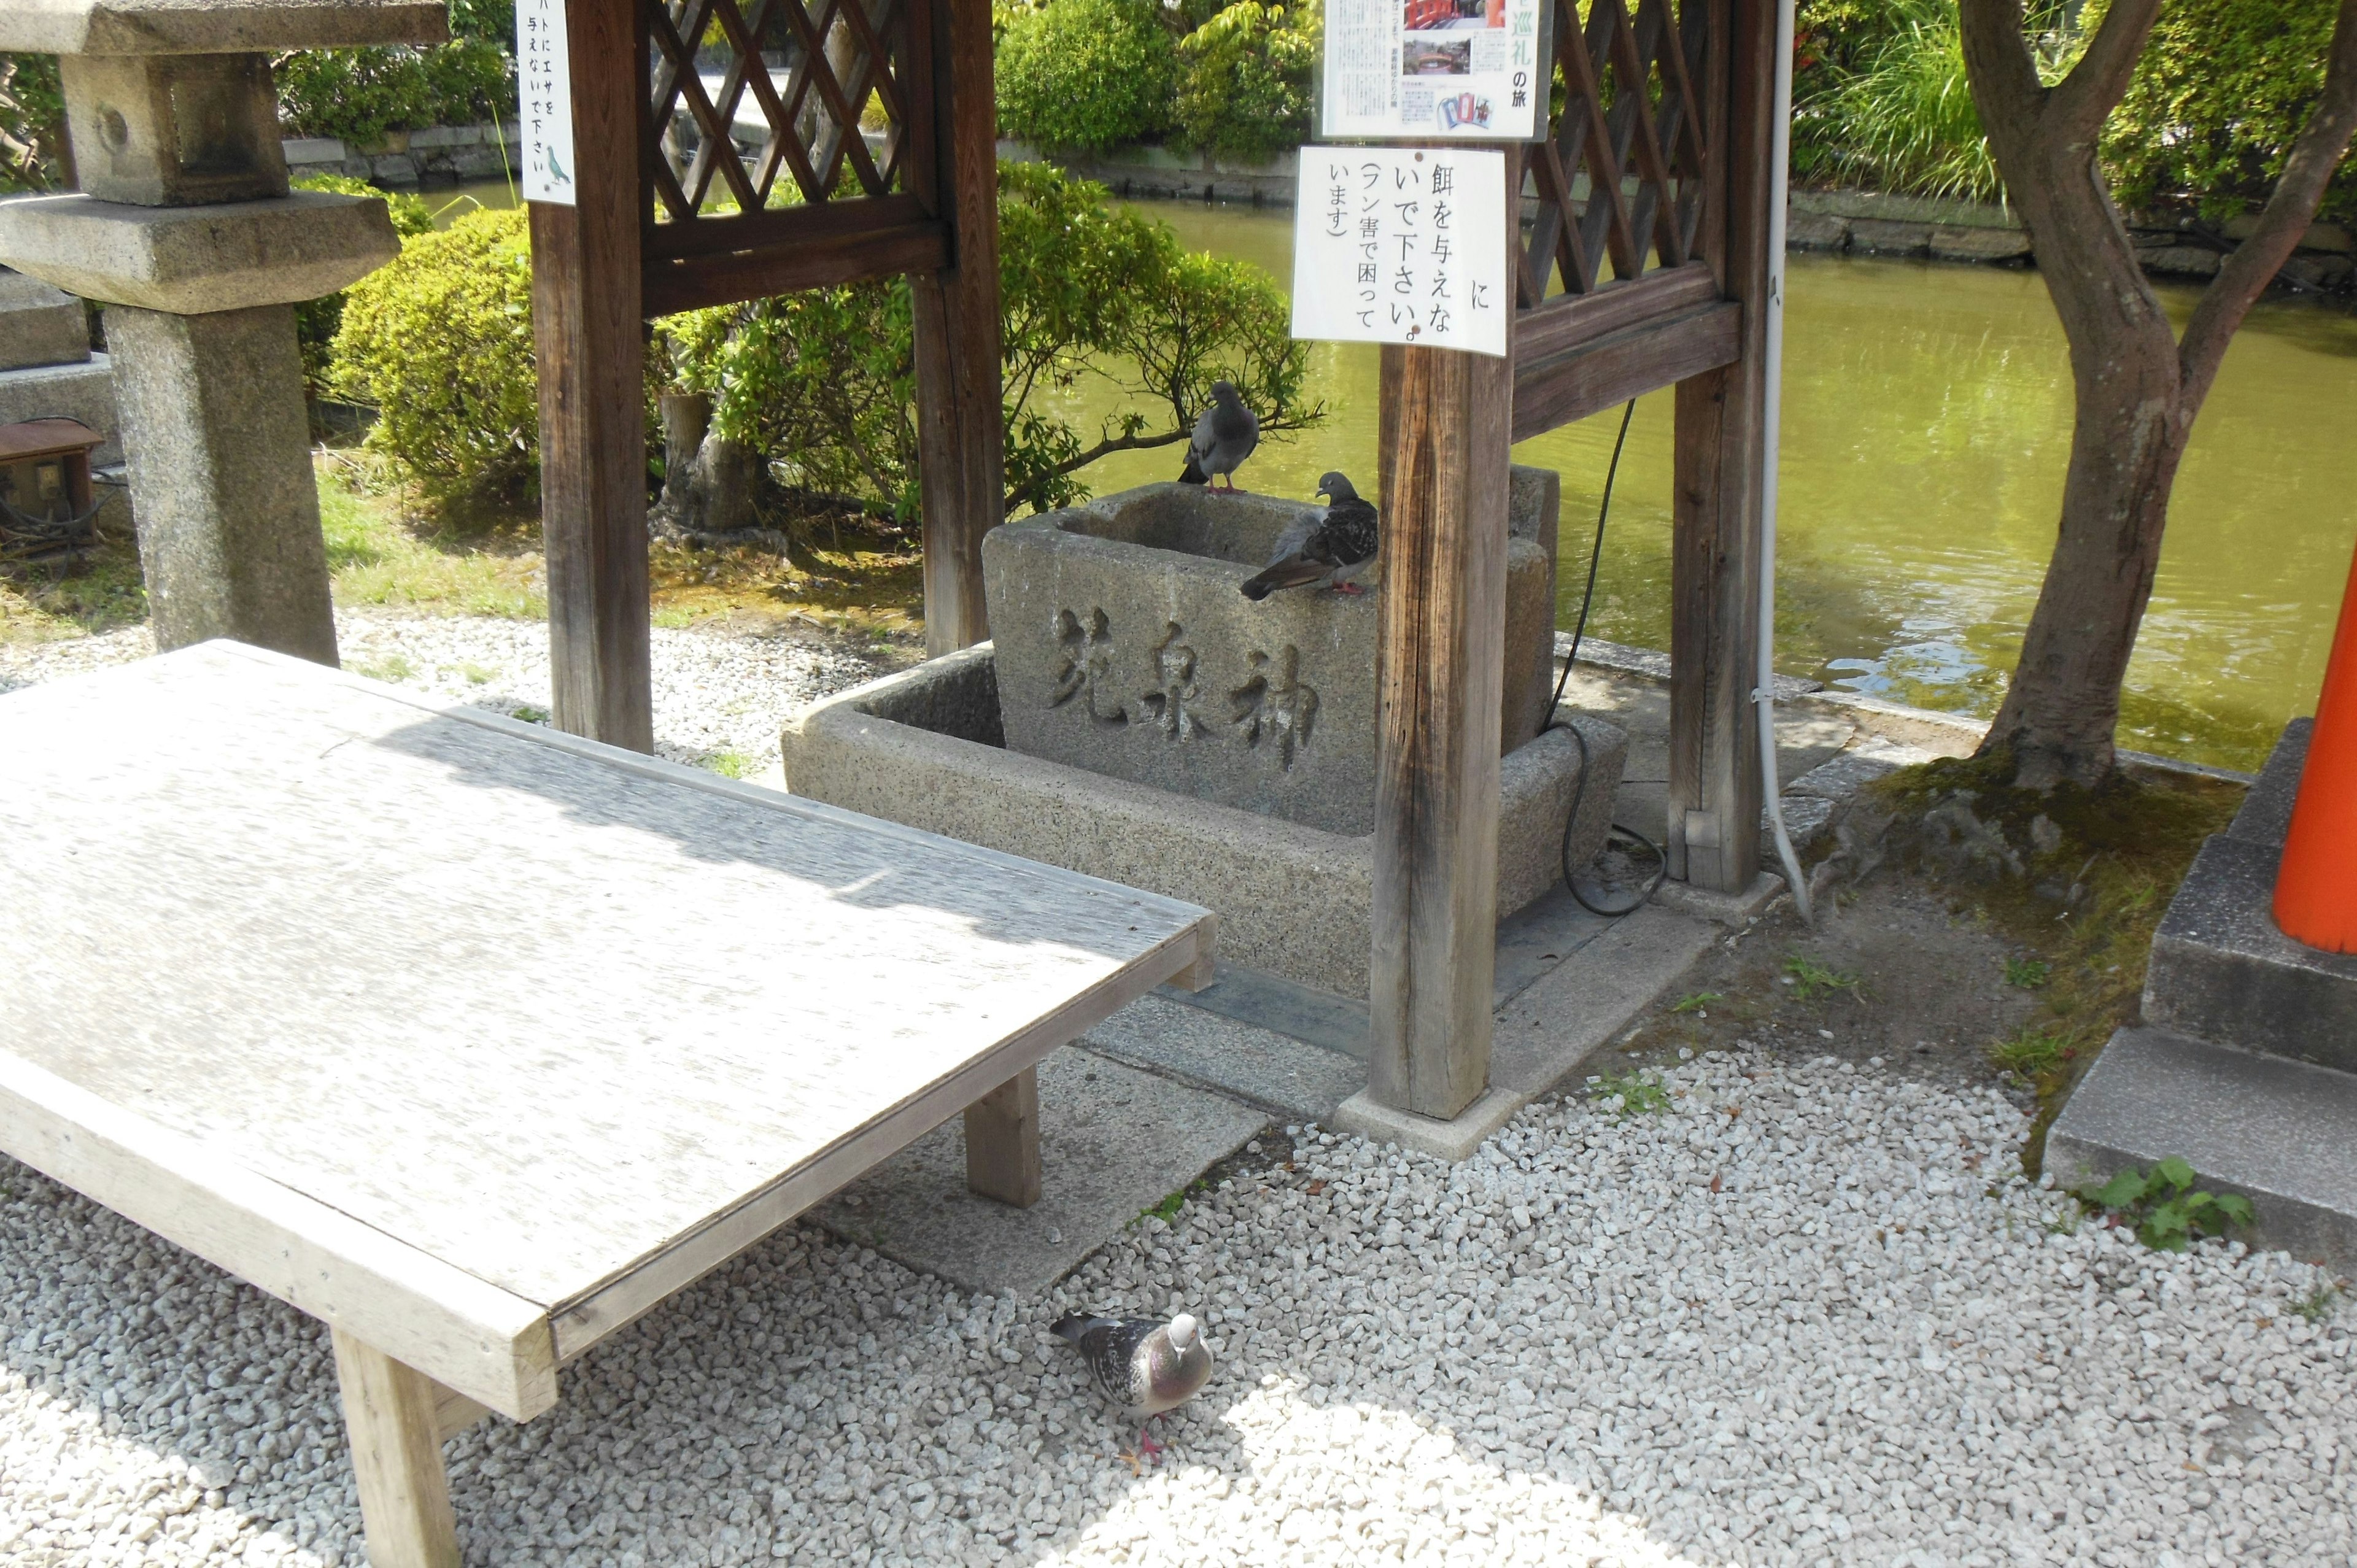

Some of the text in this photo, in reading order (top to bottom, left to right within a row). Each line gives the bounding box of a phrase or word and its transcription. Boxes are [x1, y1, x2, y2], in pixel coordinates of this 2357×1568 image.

[527, 17, 543, 172] 与えないで下さい
[540, 0, 554, 114] ハトにエサを
[1326, 164, 1349, 236] います）
[1357, 163, 1381, 327] （フン害で困って
[1390, 167, 1419, 341] いで下さい。
[1430, 164, 1453, 332] 餌を与えな
[1471, 280, 1489, 309] に
